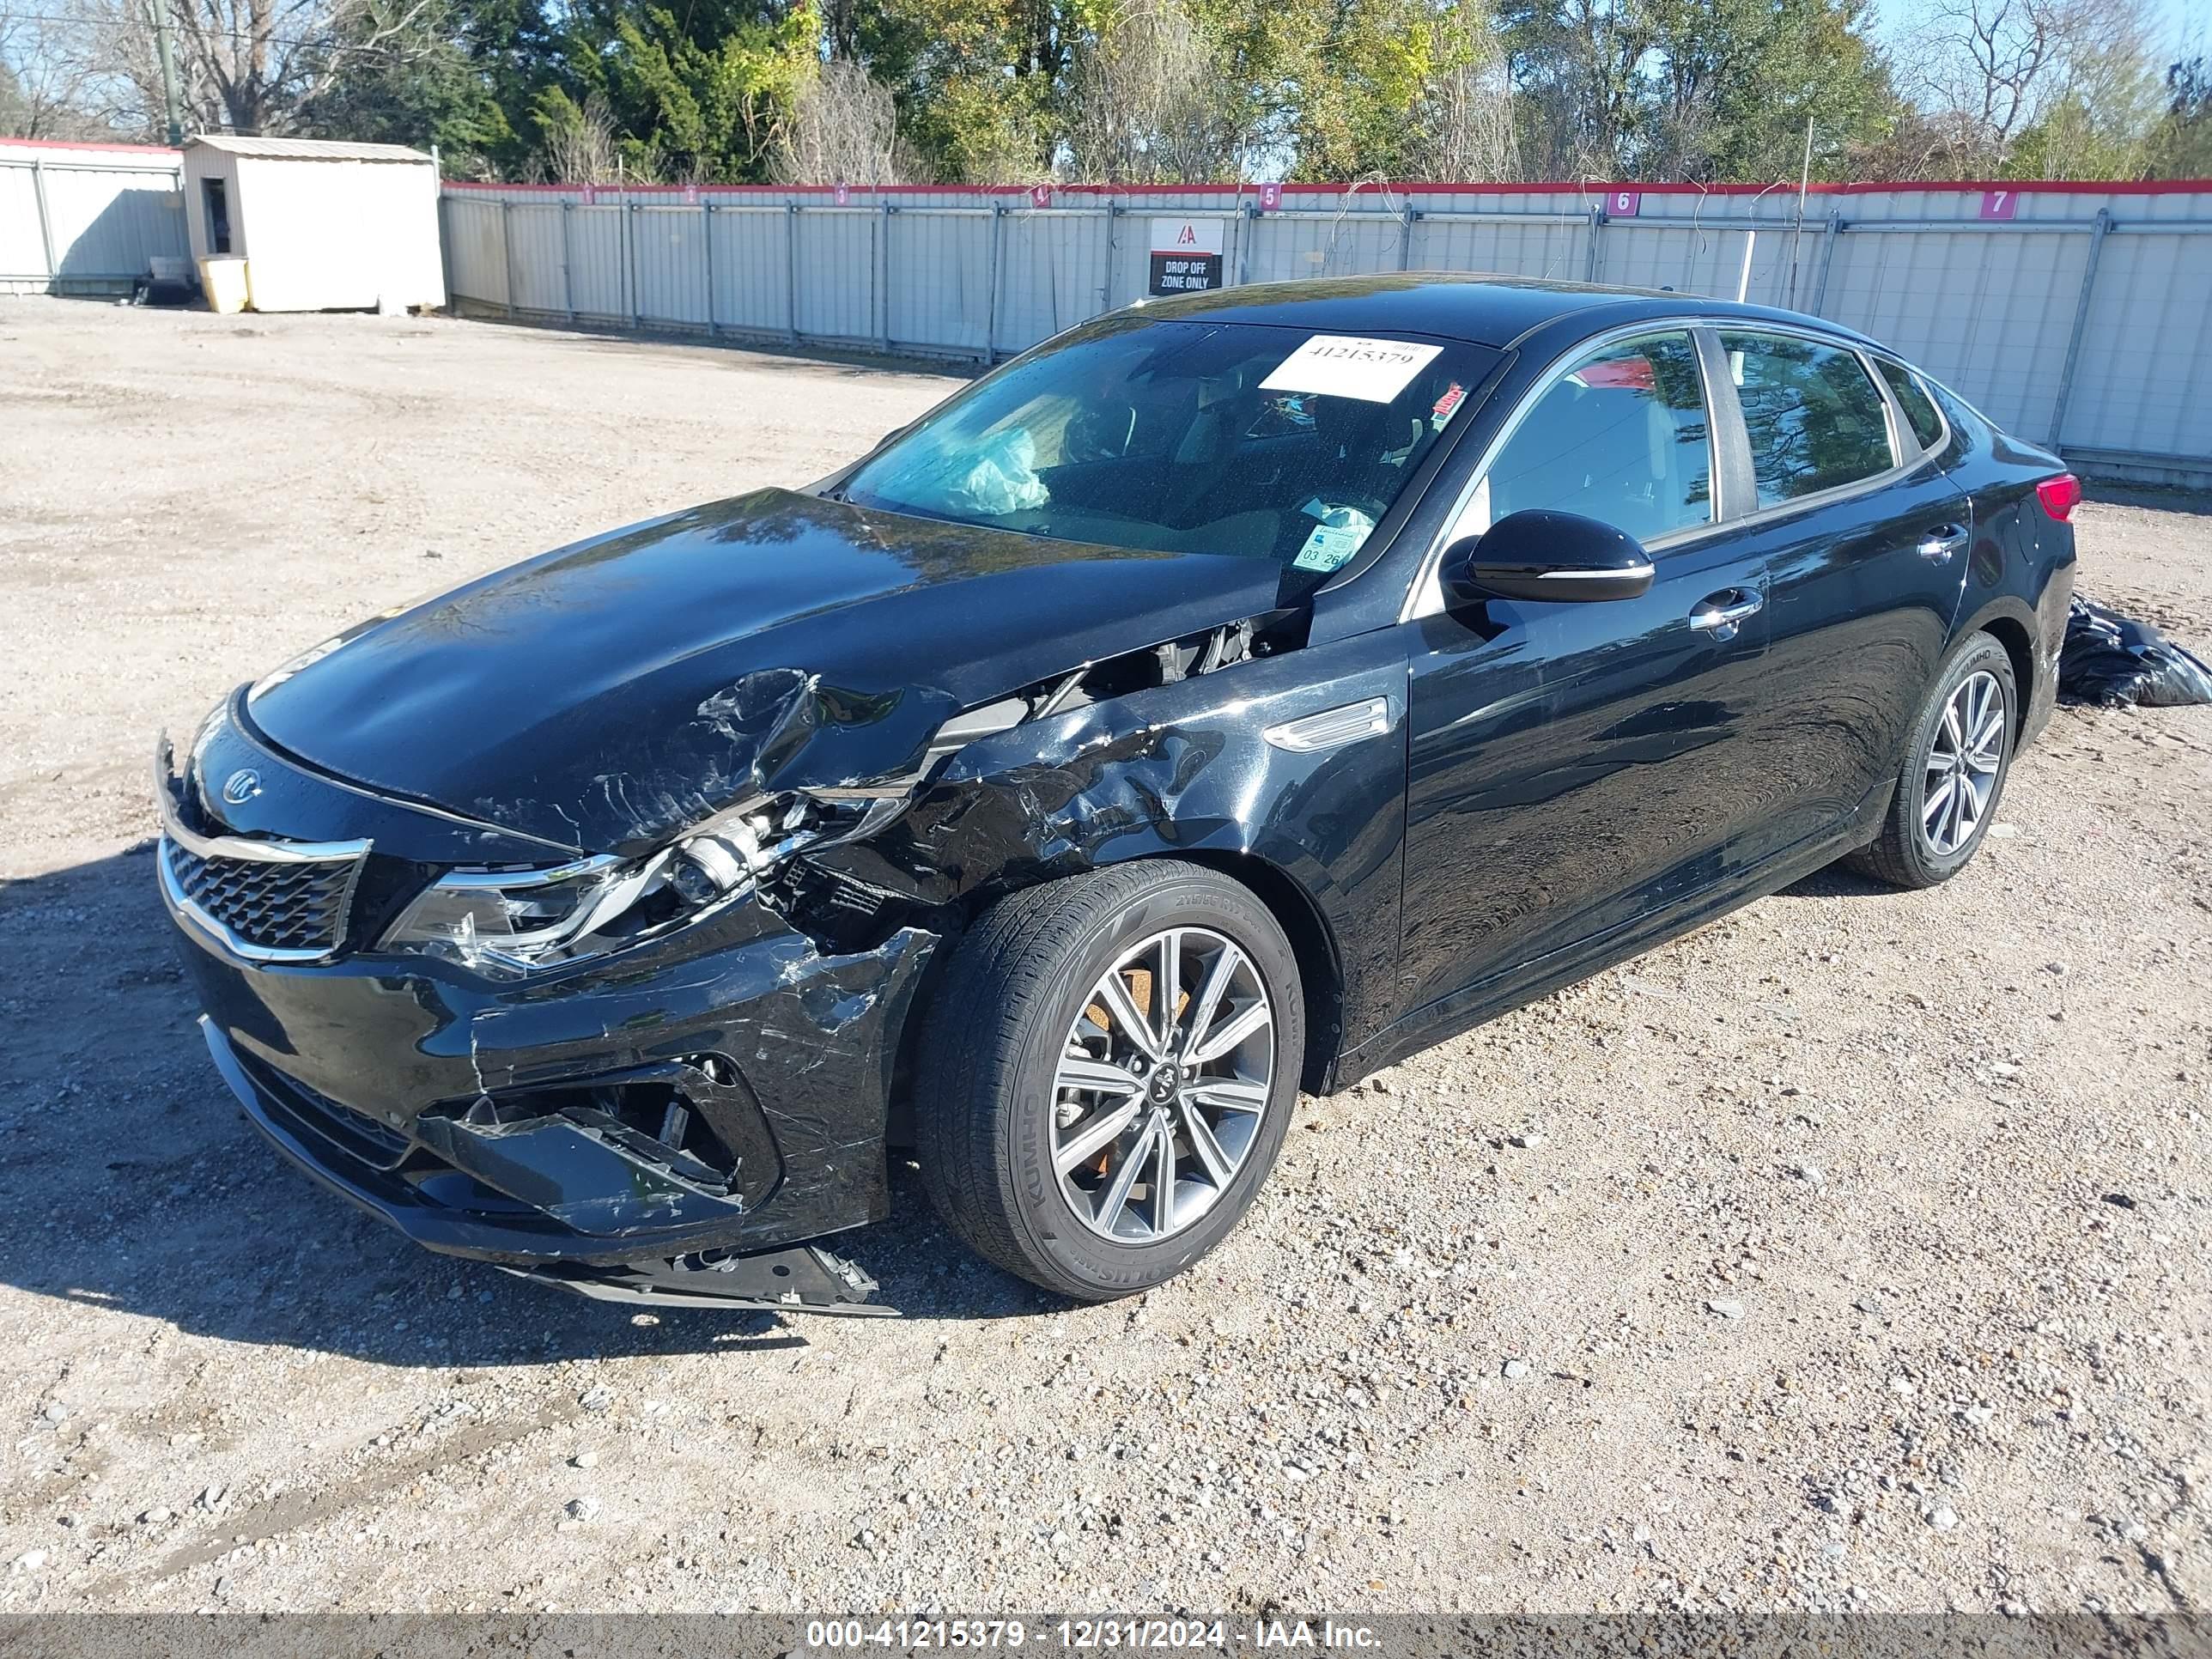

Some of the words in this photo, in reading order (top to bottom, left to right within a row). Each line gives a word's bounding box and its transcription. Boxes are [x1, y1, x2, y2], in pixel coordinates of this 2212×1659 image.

[1266, 187, 1274, 205] 5
[1617, 192, 1631, 210] 6
[1993, 191, 2008, 212] 7
[1165, 261, 1189, 274] DROP
[1190, 262, 1206, 275] OFF
[1161, 275, 1185, 289] ZONE
[1186, 276, 1209, 289] ONLY
[1309, 346, 1414, 365] 41215379
[1304, 550, 1319, 561] 03
[1324, 554, 1340, 565] 26
[1022, 1093, 1046, 1209] KUMHO
